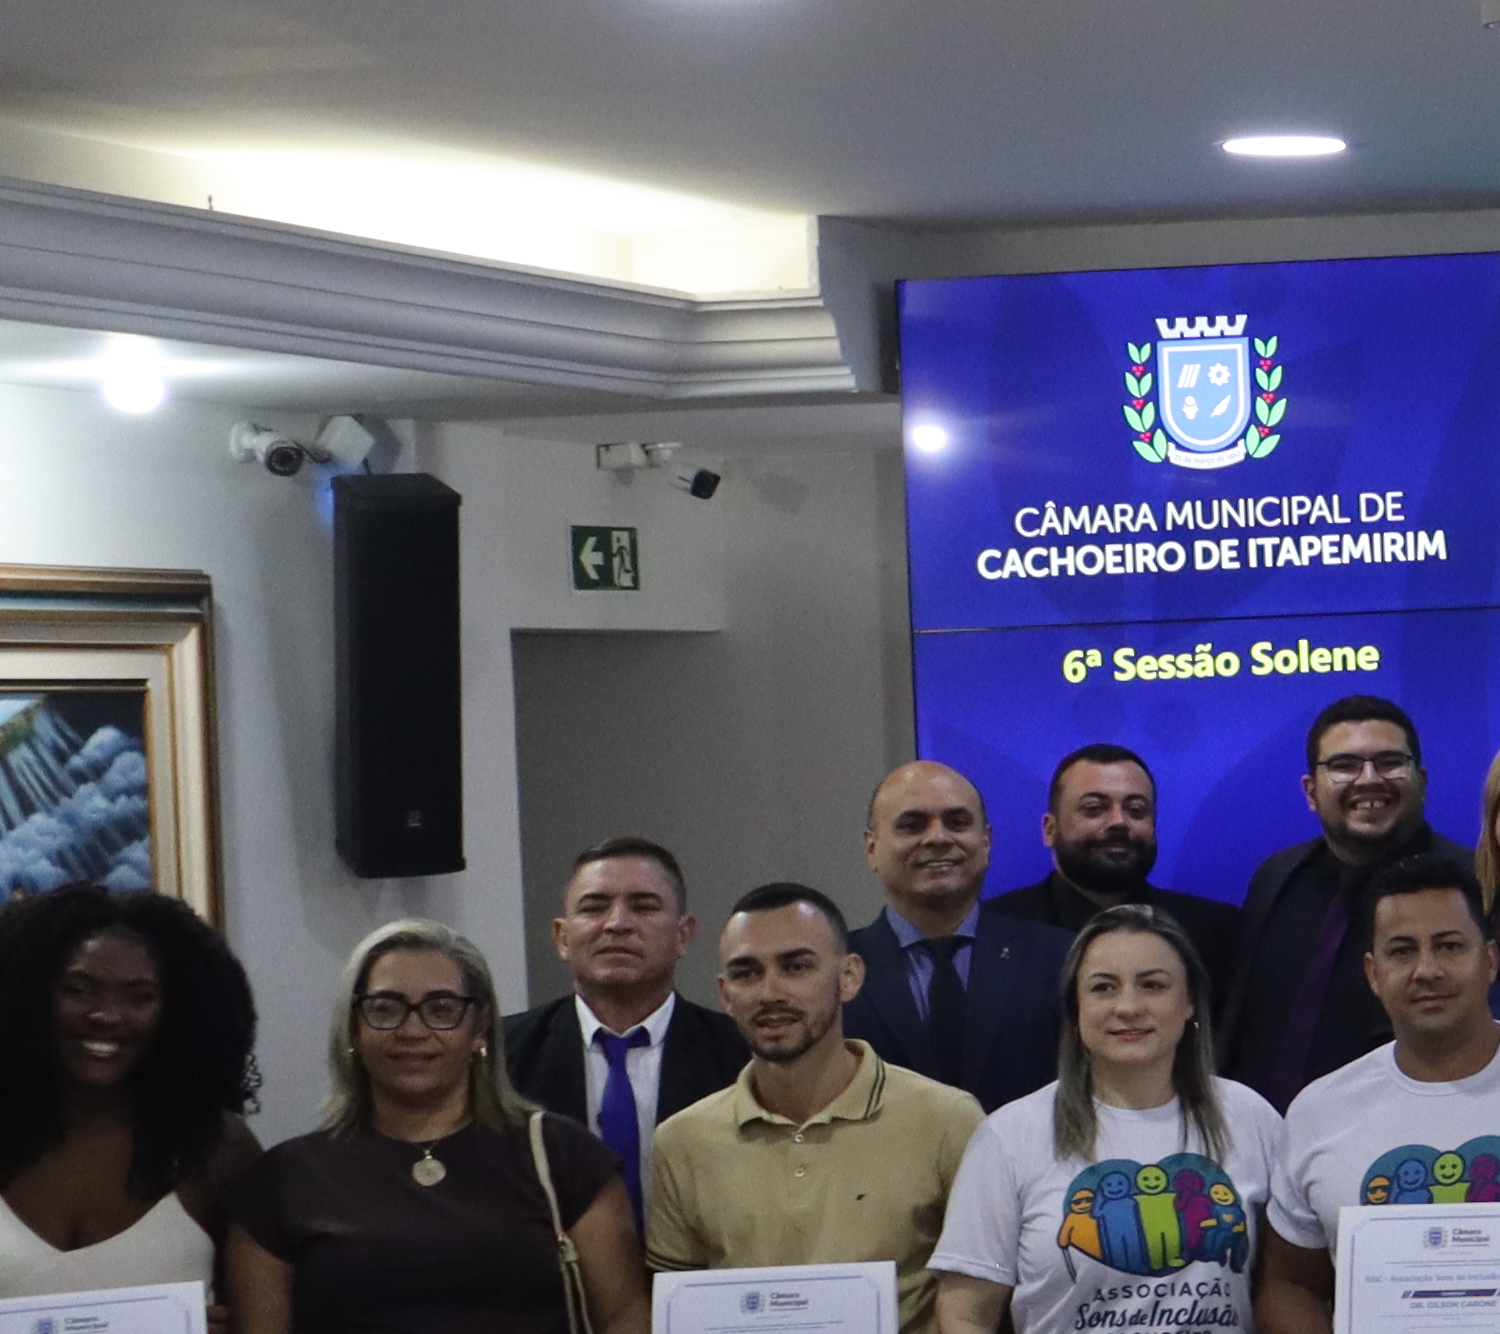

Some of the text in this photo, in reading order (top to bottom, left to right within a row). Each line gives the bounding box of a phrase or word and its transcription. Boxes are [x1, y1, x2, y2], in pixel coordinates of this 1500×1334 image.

[1015, 492, 1404, 537] CÂMARA MUNICIPAL DE
[977, 530, 1446, 579] CACHOEIRO DE ITAPEMIRIM
[1113, 643, 1240, 681] Sessão
[1251, 639, 1379, 675] Solene
[1075, 1303, 1129, 1331] Sons
